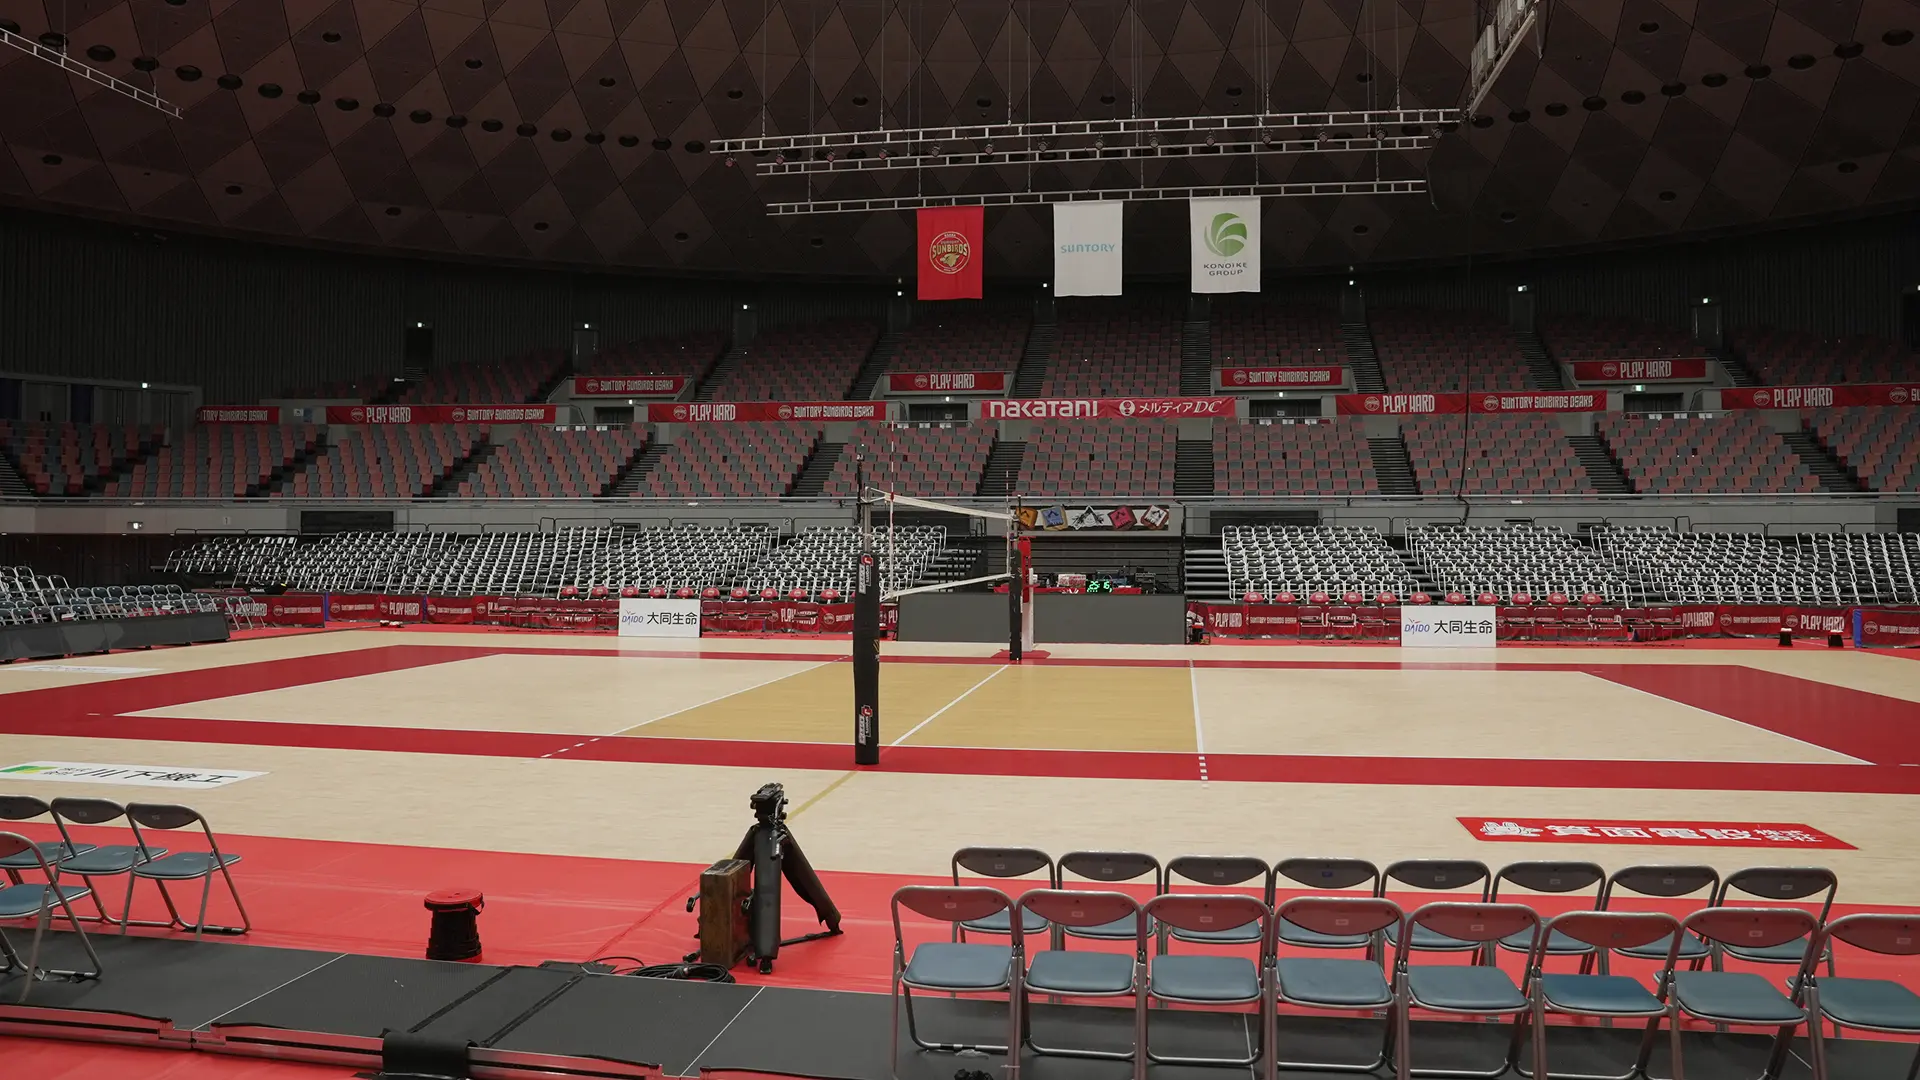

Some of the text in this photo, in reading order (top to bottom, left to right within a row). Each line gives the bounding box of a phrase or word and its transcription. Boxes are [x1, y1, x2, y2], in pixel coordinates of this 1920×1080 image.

[932, 243, 967, 258] SUNBIRDS
[1060, 243, 1115, 253] SUNTORY
[1249, 371, 1330, 383] SUNTORY SUNBIRDS OSAKA
[1620, 361, 1672, 378] PLAY HARD
[600, 379, 673, 391] SUNTORY SUNBIRDS OSAKA
[930, 373, 975, 389] PLAY HARD
[1383, 394, 1435, 413] PLAY HARD
[1501, 395, 1593, 409] SUNTORY SUNBIRDS OSAKA
[1774, 387, 1833, 407] PLAY HARD
[366, 406, 411, 423] PLAY HARD
[467, 408, 545, 421] SUNTORY SUNBIRDS OSAKA
[689, 404, 736, 421] PLAY HARD
[793, 405, 874, 418] SUNTORY SUNBIRDS OSAKA
[389, 601, 403, 615] PLAY
[404, 602, 419, 616] HARD
[621, 613, 644, 625] DAIDO
[647, 612, 698, 625] 大同生命
[1215, 612, 1228, 627] PLAY
[1694, 611, 1714, 627] HARD
[1800, 614, 1845, 631] PLAY HARD
[1404, 621, 1430, 634] DAIDO
[1434, 620, 1493, 634] 大同生命
